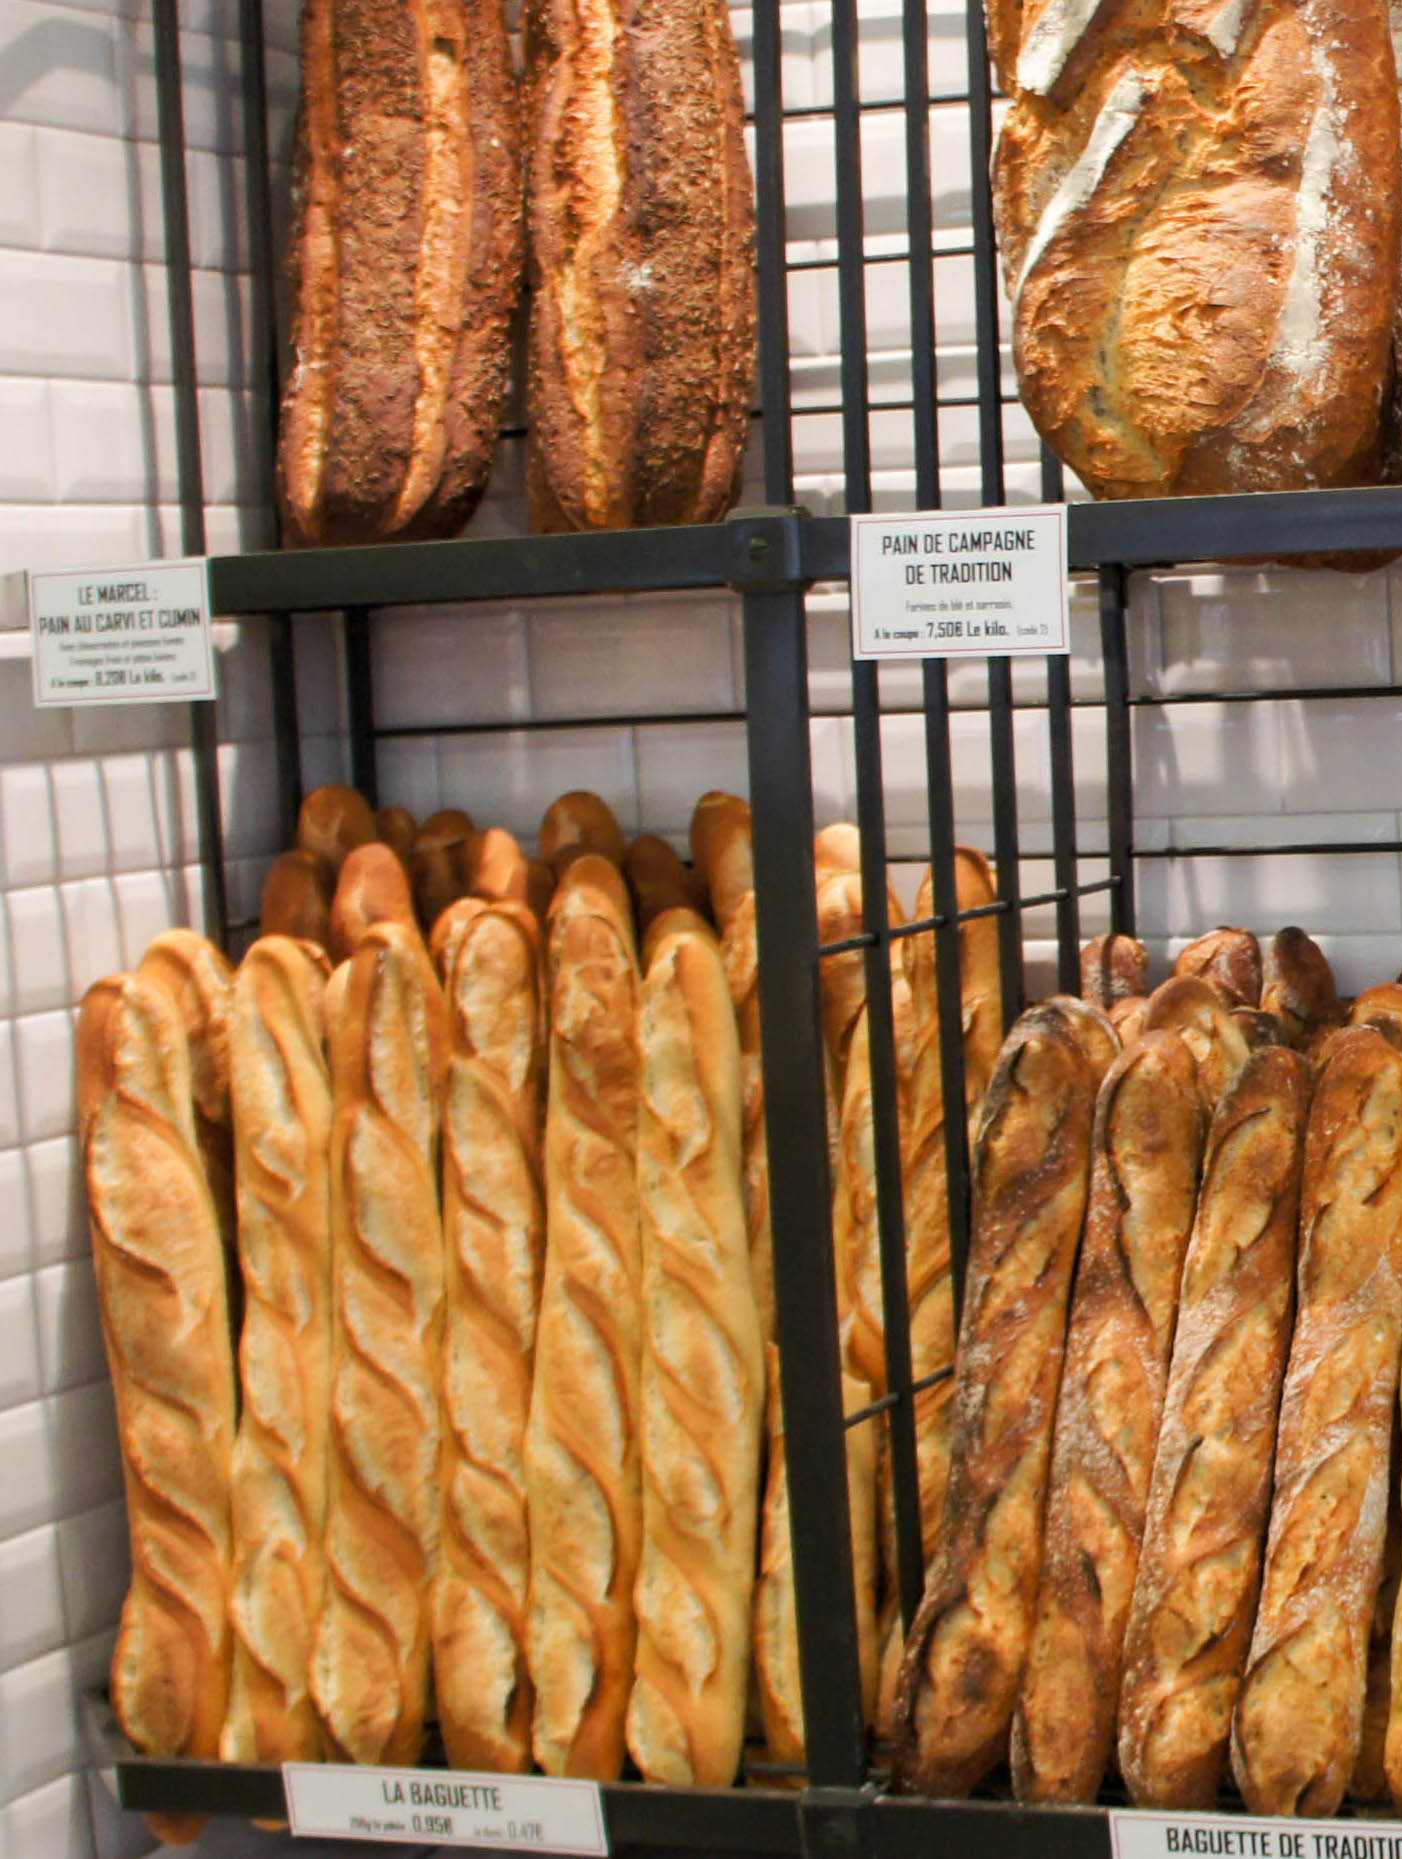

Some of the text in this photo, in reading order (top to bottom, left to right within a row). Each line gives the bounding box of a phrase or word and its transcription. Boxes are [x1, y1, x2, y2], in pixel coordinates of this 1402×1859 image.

[882, 530, 1035, 555] PAIN DE CAMPAGNE
[906, 562, 1012, 584] DE TRADITION
[78, 586, 93, 605] LE
[98, 583, 150, 603] MARCEL
[38, 608, 200, 636] PAIN AU CARVI ET CUMIN
[893, 630, 918, 641] coupe
[926, 622, 962, 639] 7,50€
[967, 622, 981, 637] Le
[985, 621, 1009, 636] kilo.
[382, 1780, 503, 1811] LA BAGUETTE
[1166, 1827, 1271, 1857] BAGUETTE
[1279, 1834, 1304, 1858] DE
